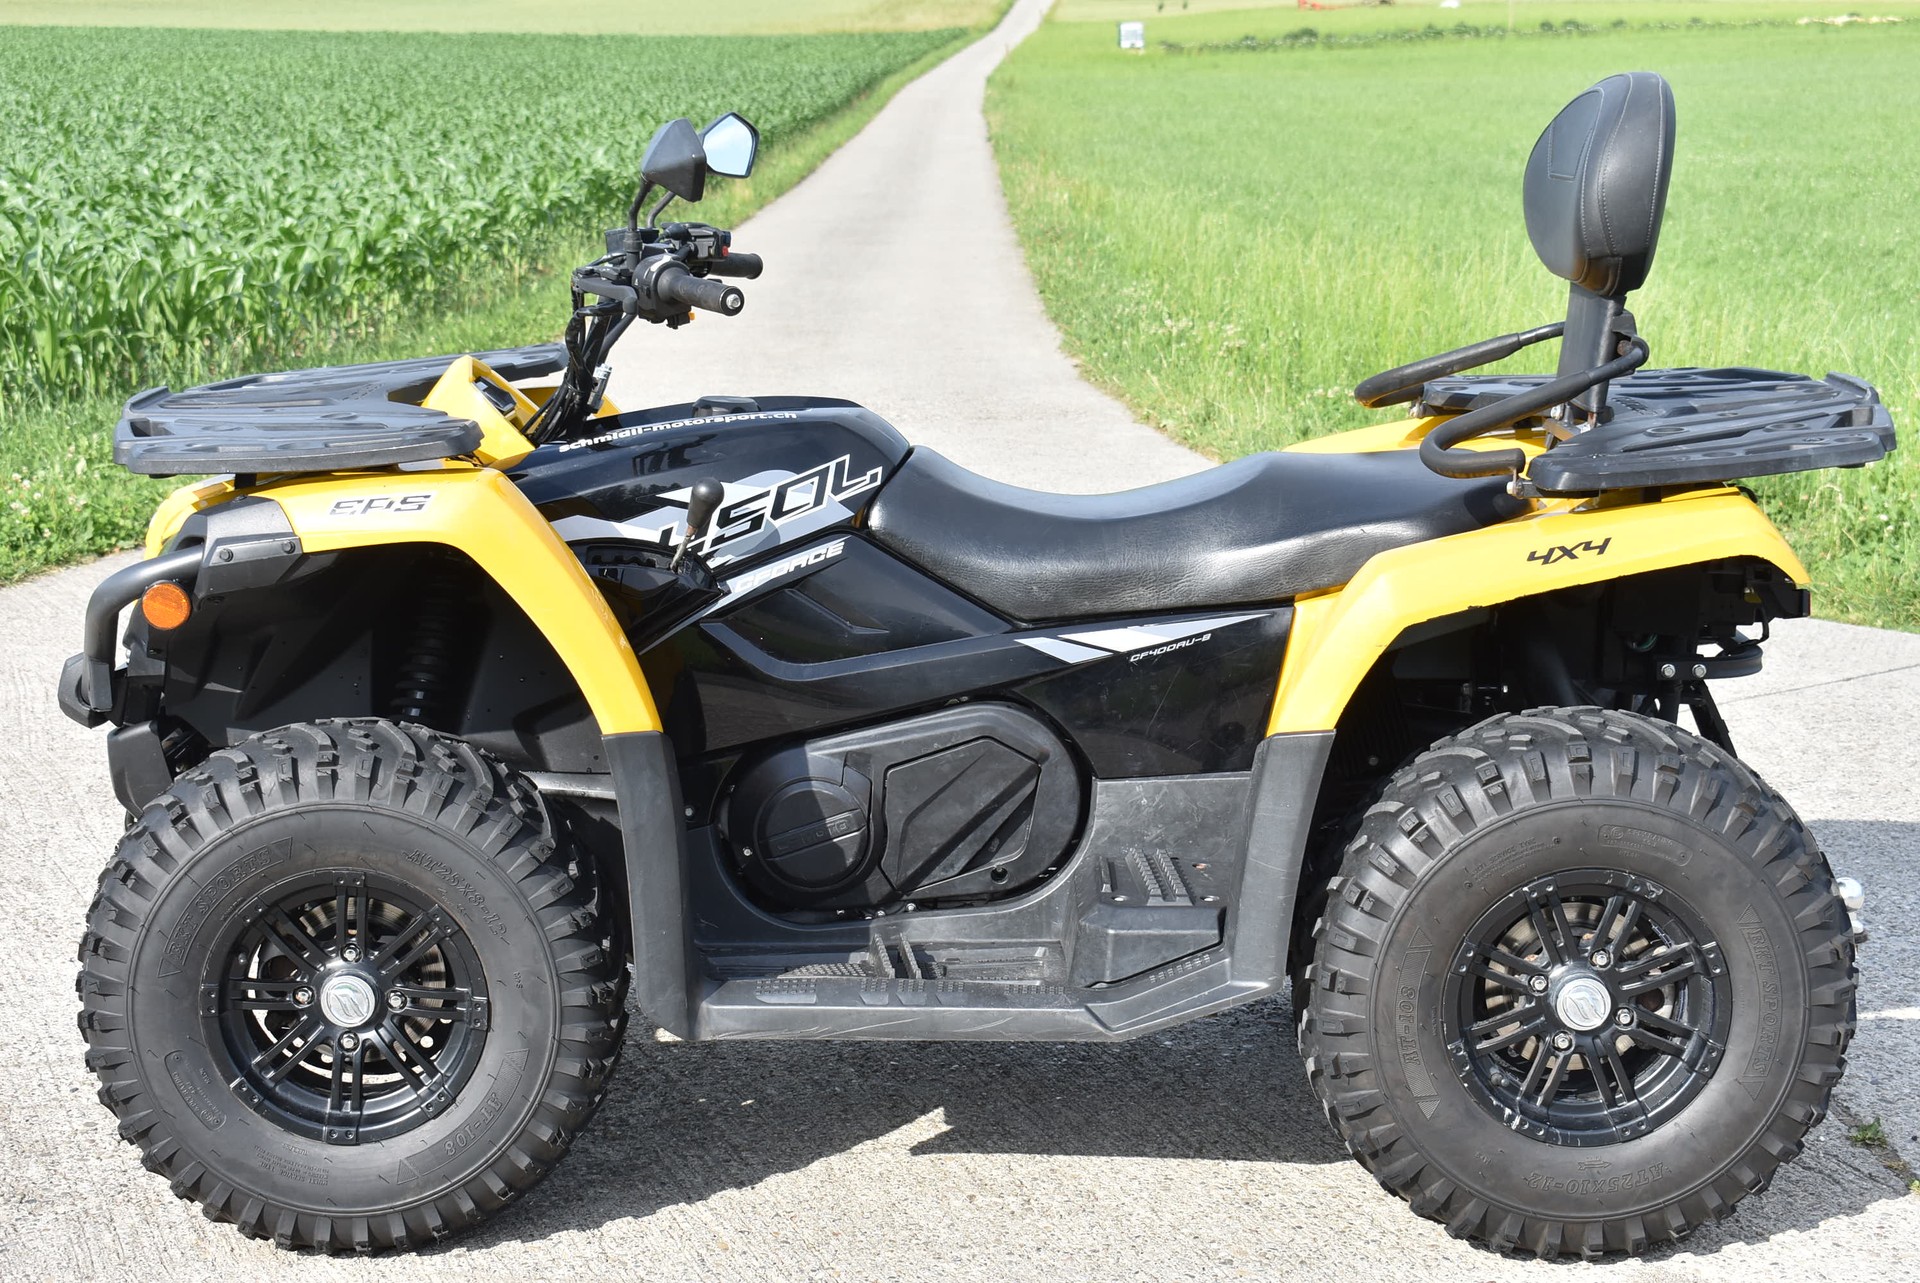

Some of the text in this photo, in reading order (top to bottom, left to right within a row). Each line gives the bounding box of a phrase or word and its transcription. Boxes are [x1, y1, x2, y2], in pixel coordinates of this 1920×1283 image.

[328, 494, 432, 516] EPS
[734, 541, 845, 594] CFORCE
[195, 848, 272, 915] SPORTS
[1398, 985, 1422, 1066] AT-108
[1747, 927, 1779, 1076] BKT SPORTS
[443, 1091, 503, 1157] AT-108
[1527, 1162, 1666, 1196] AT25X10-12
